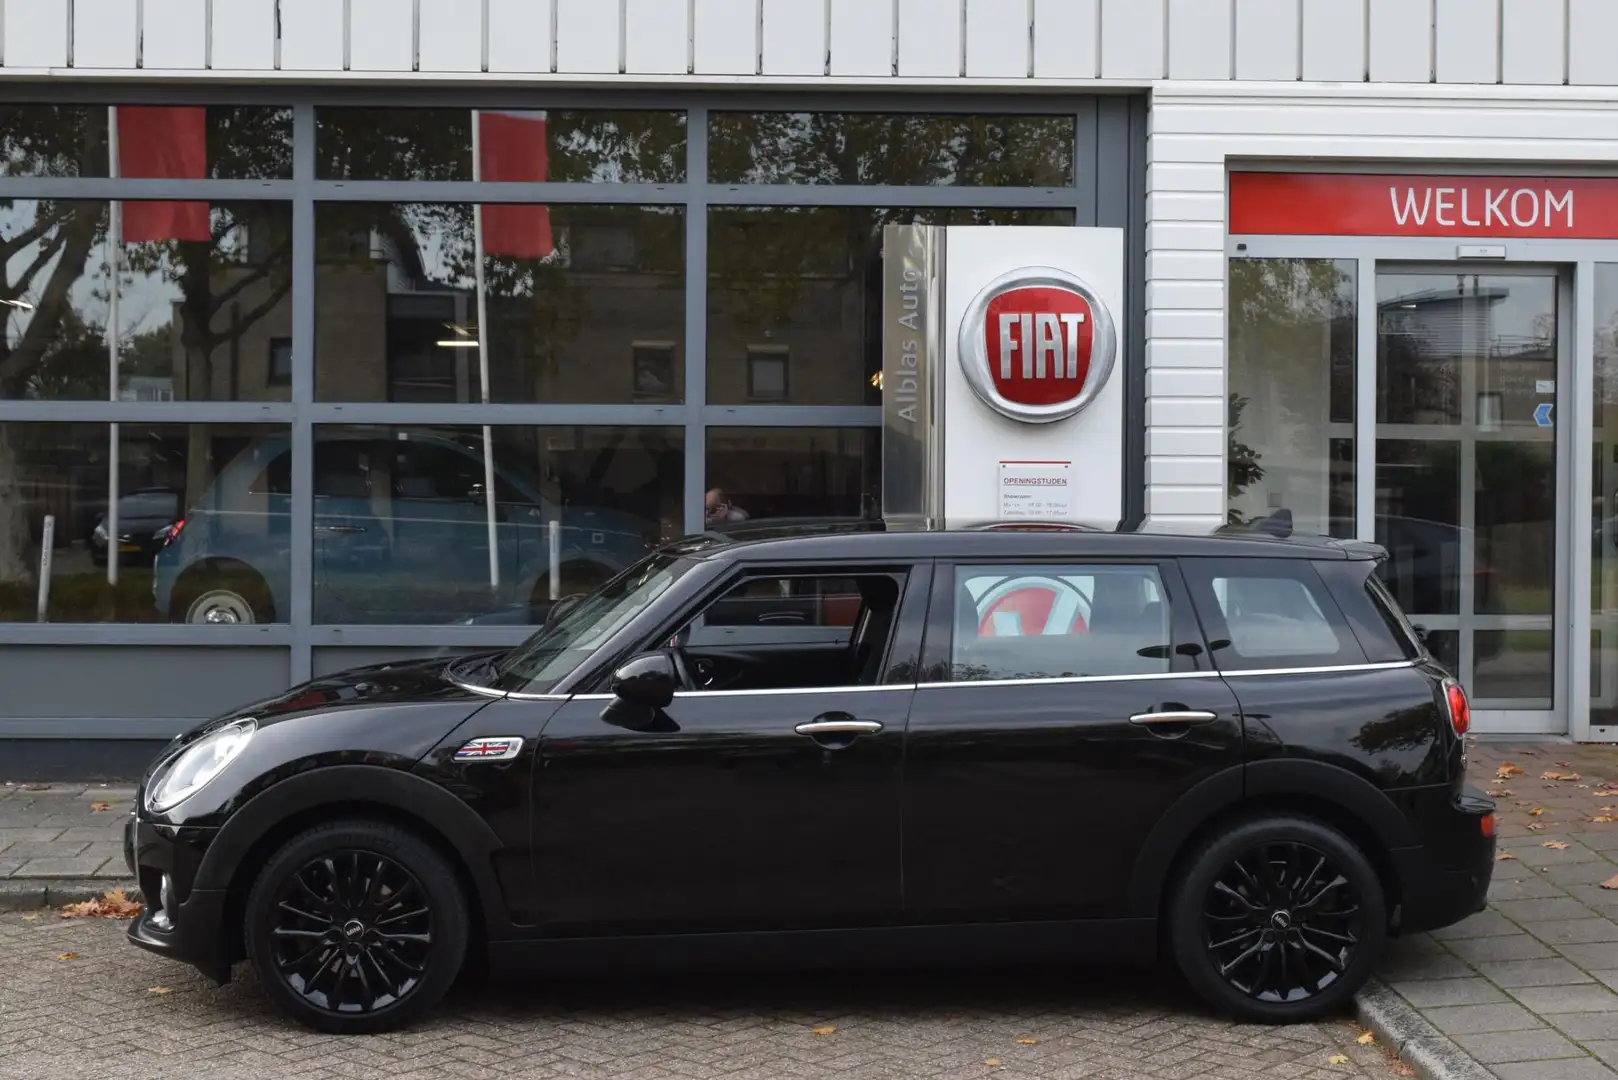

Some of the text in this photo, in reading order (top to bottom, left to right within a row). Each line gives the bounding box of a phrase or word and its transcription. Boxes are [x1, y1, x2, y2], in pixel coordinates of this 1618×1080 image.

[1390, 187, 1574, 228] WELKOM
[893, 267, 919, 423] Alblas Auto
[999, 313, 1085, 379] FIAT
[1003, 477, 1067, 485] OPENINGSTIJDEN
